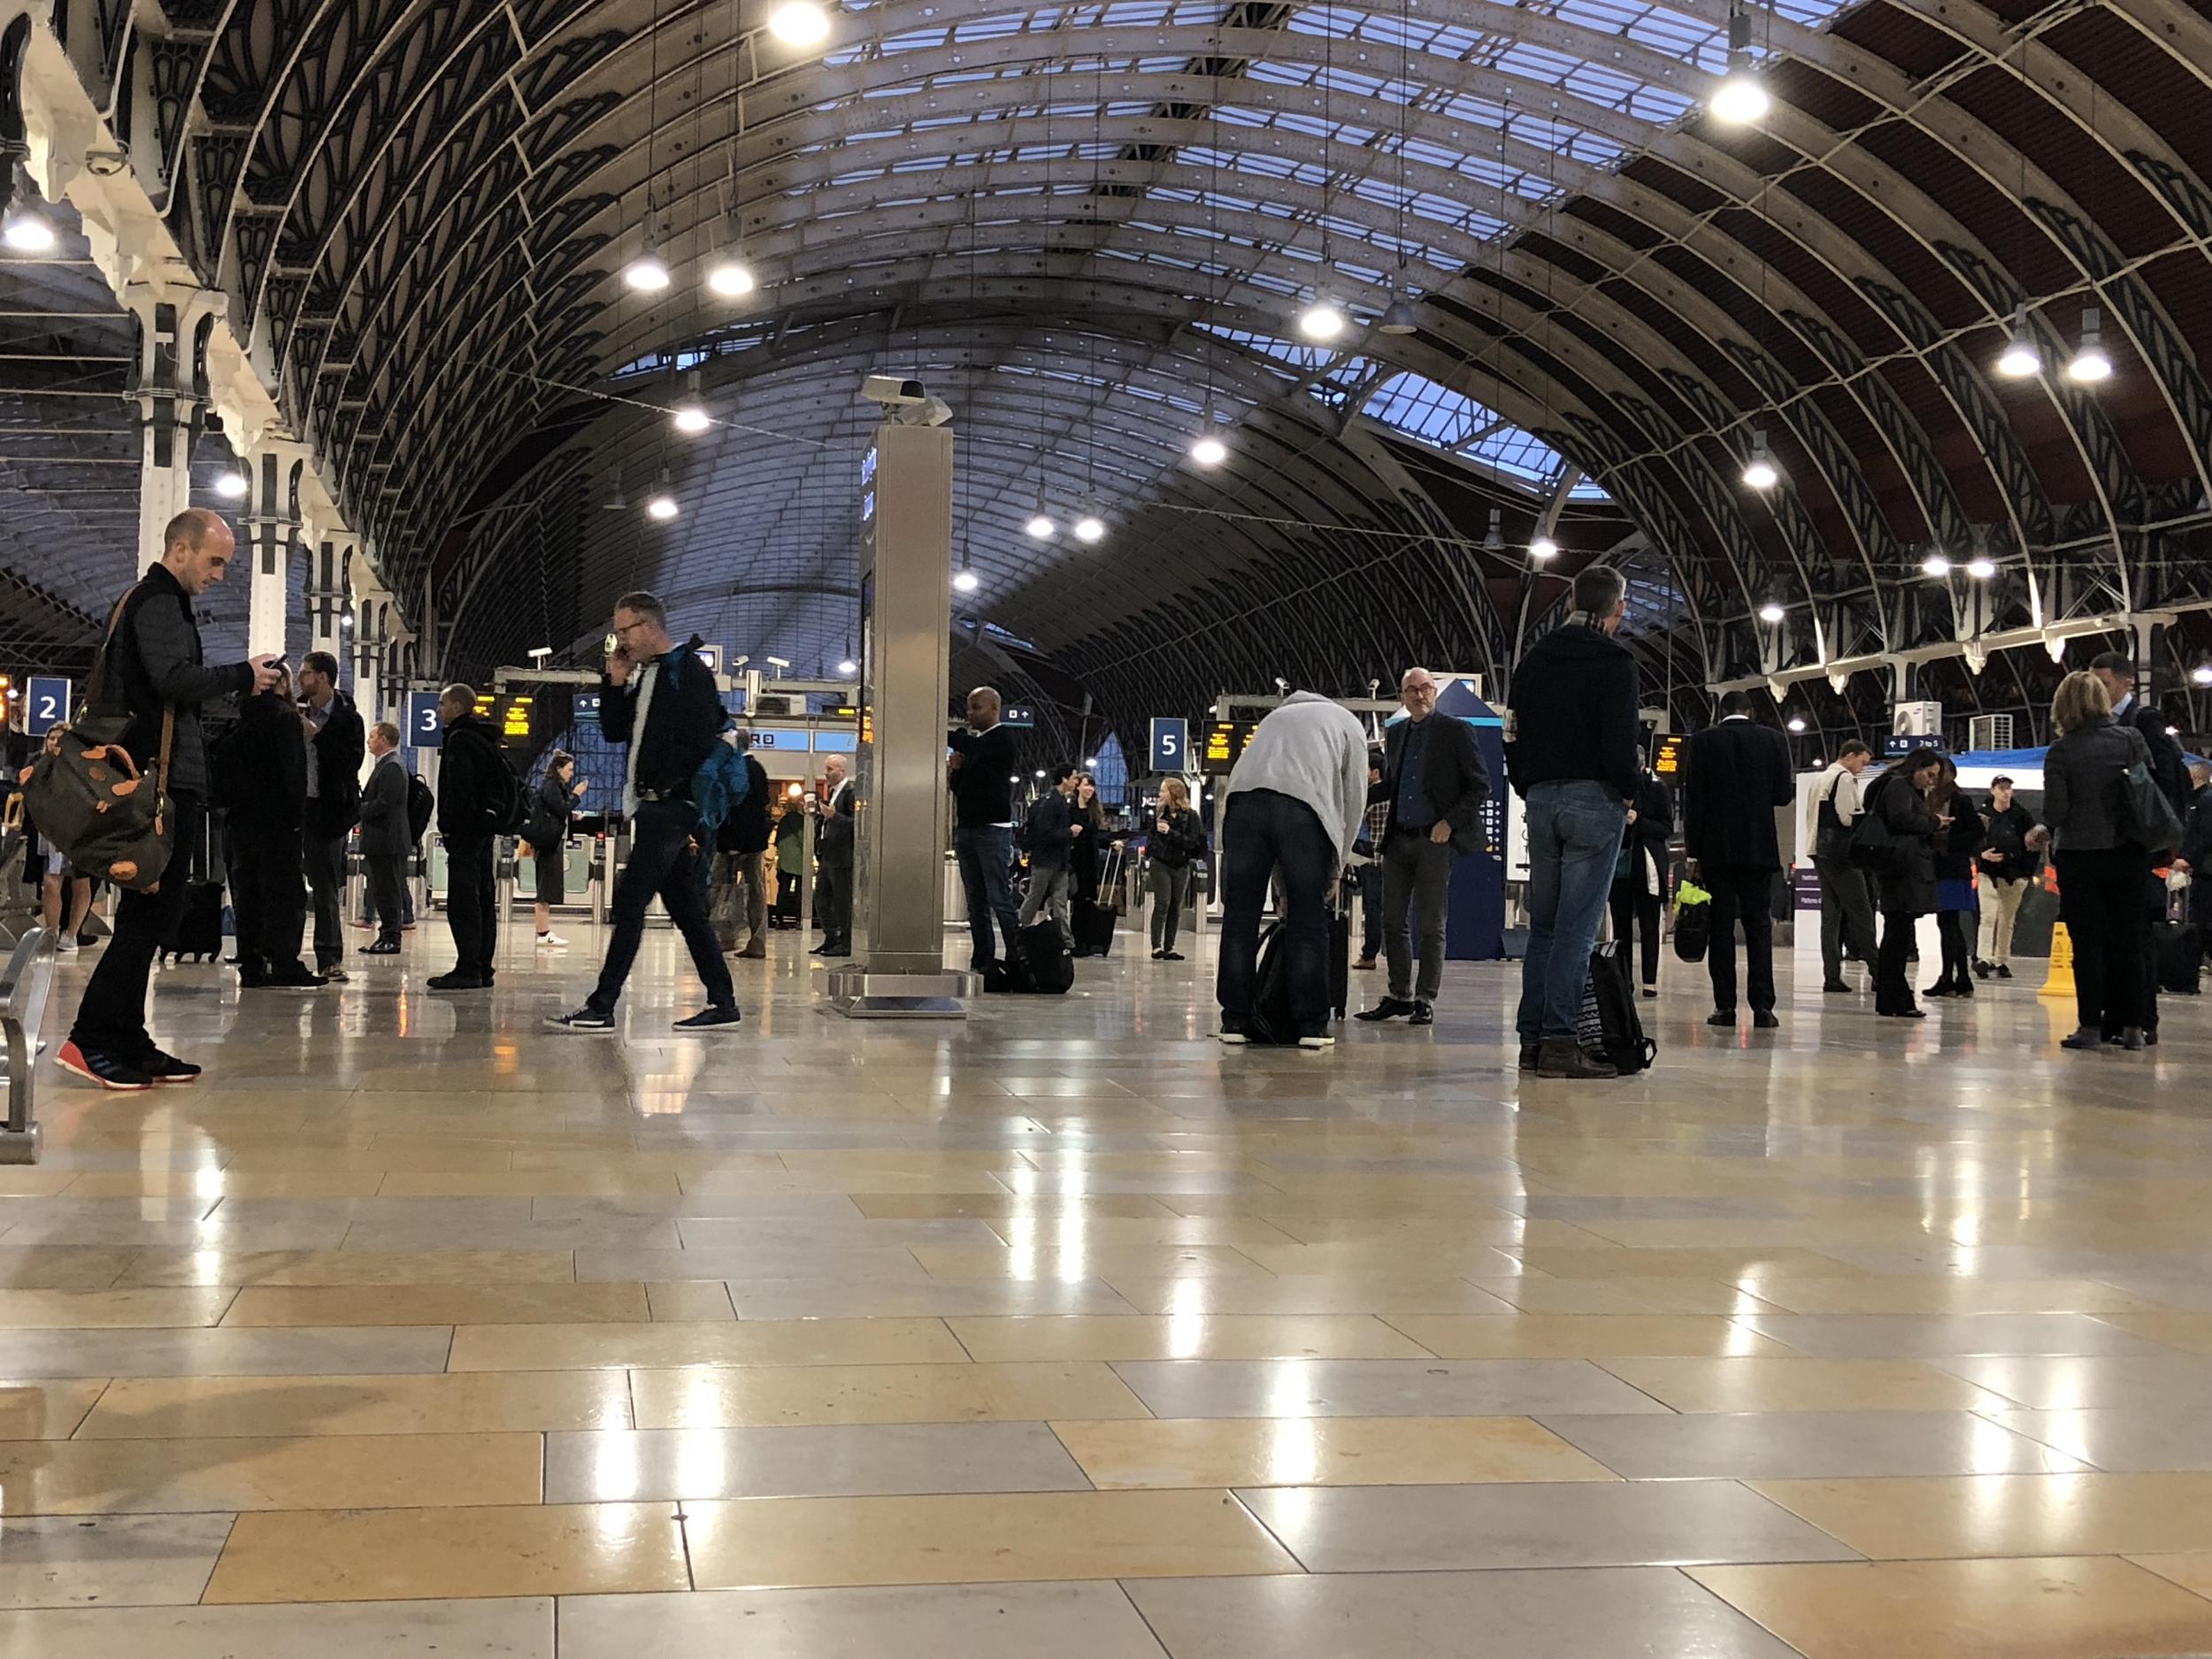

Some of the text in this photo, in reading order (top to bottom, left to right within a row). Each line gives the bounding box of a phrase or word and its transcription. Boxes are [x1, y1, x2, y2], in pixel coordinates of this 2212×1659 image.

[40, 696, 56, 718] 2
[420, 709, 437, 732] 3
[1162, 734, 1177, 756] 5
